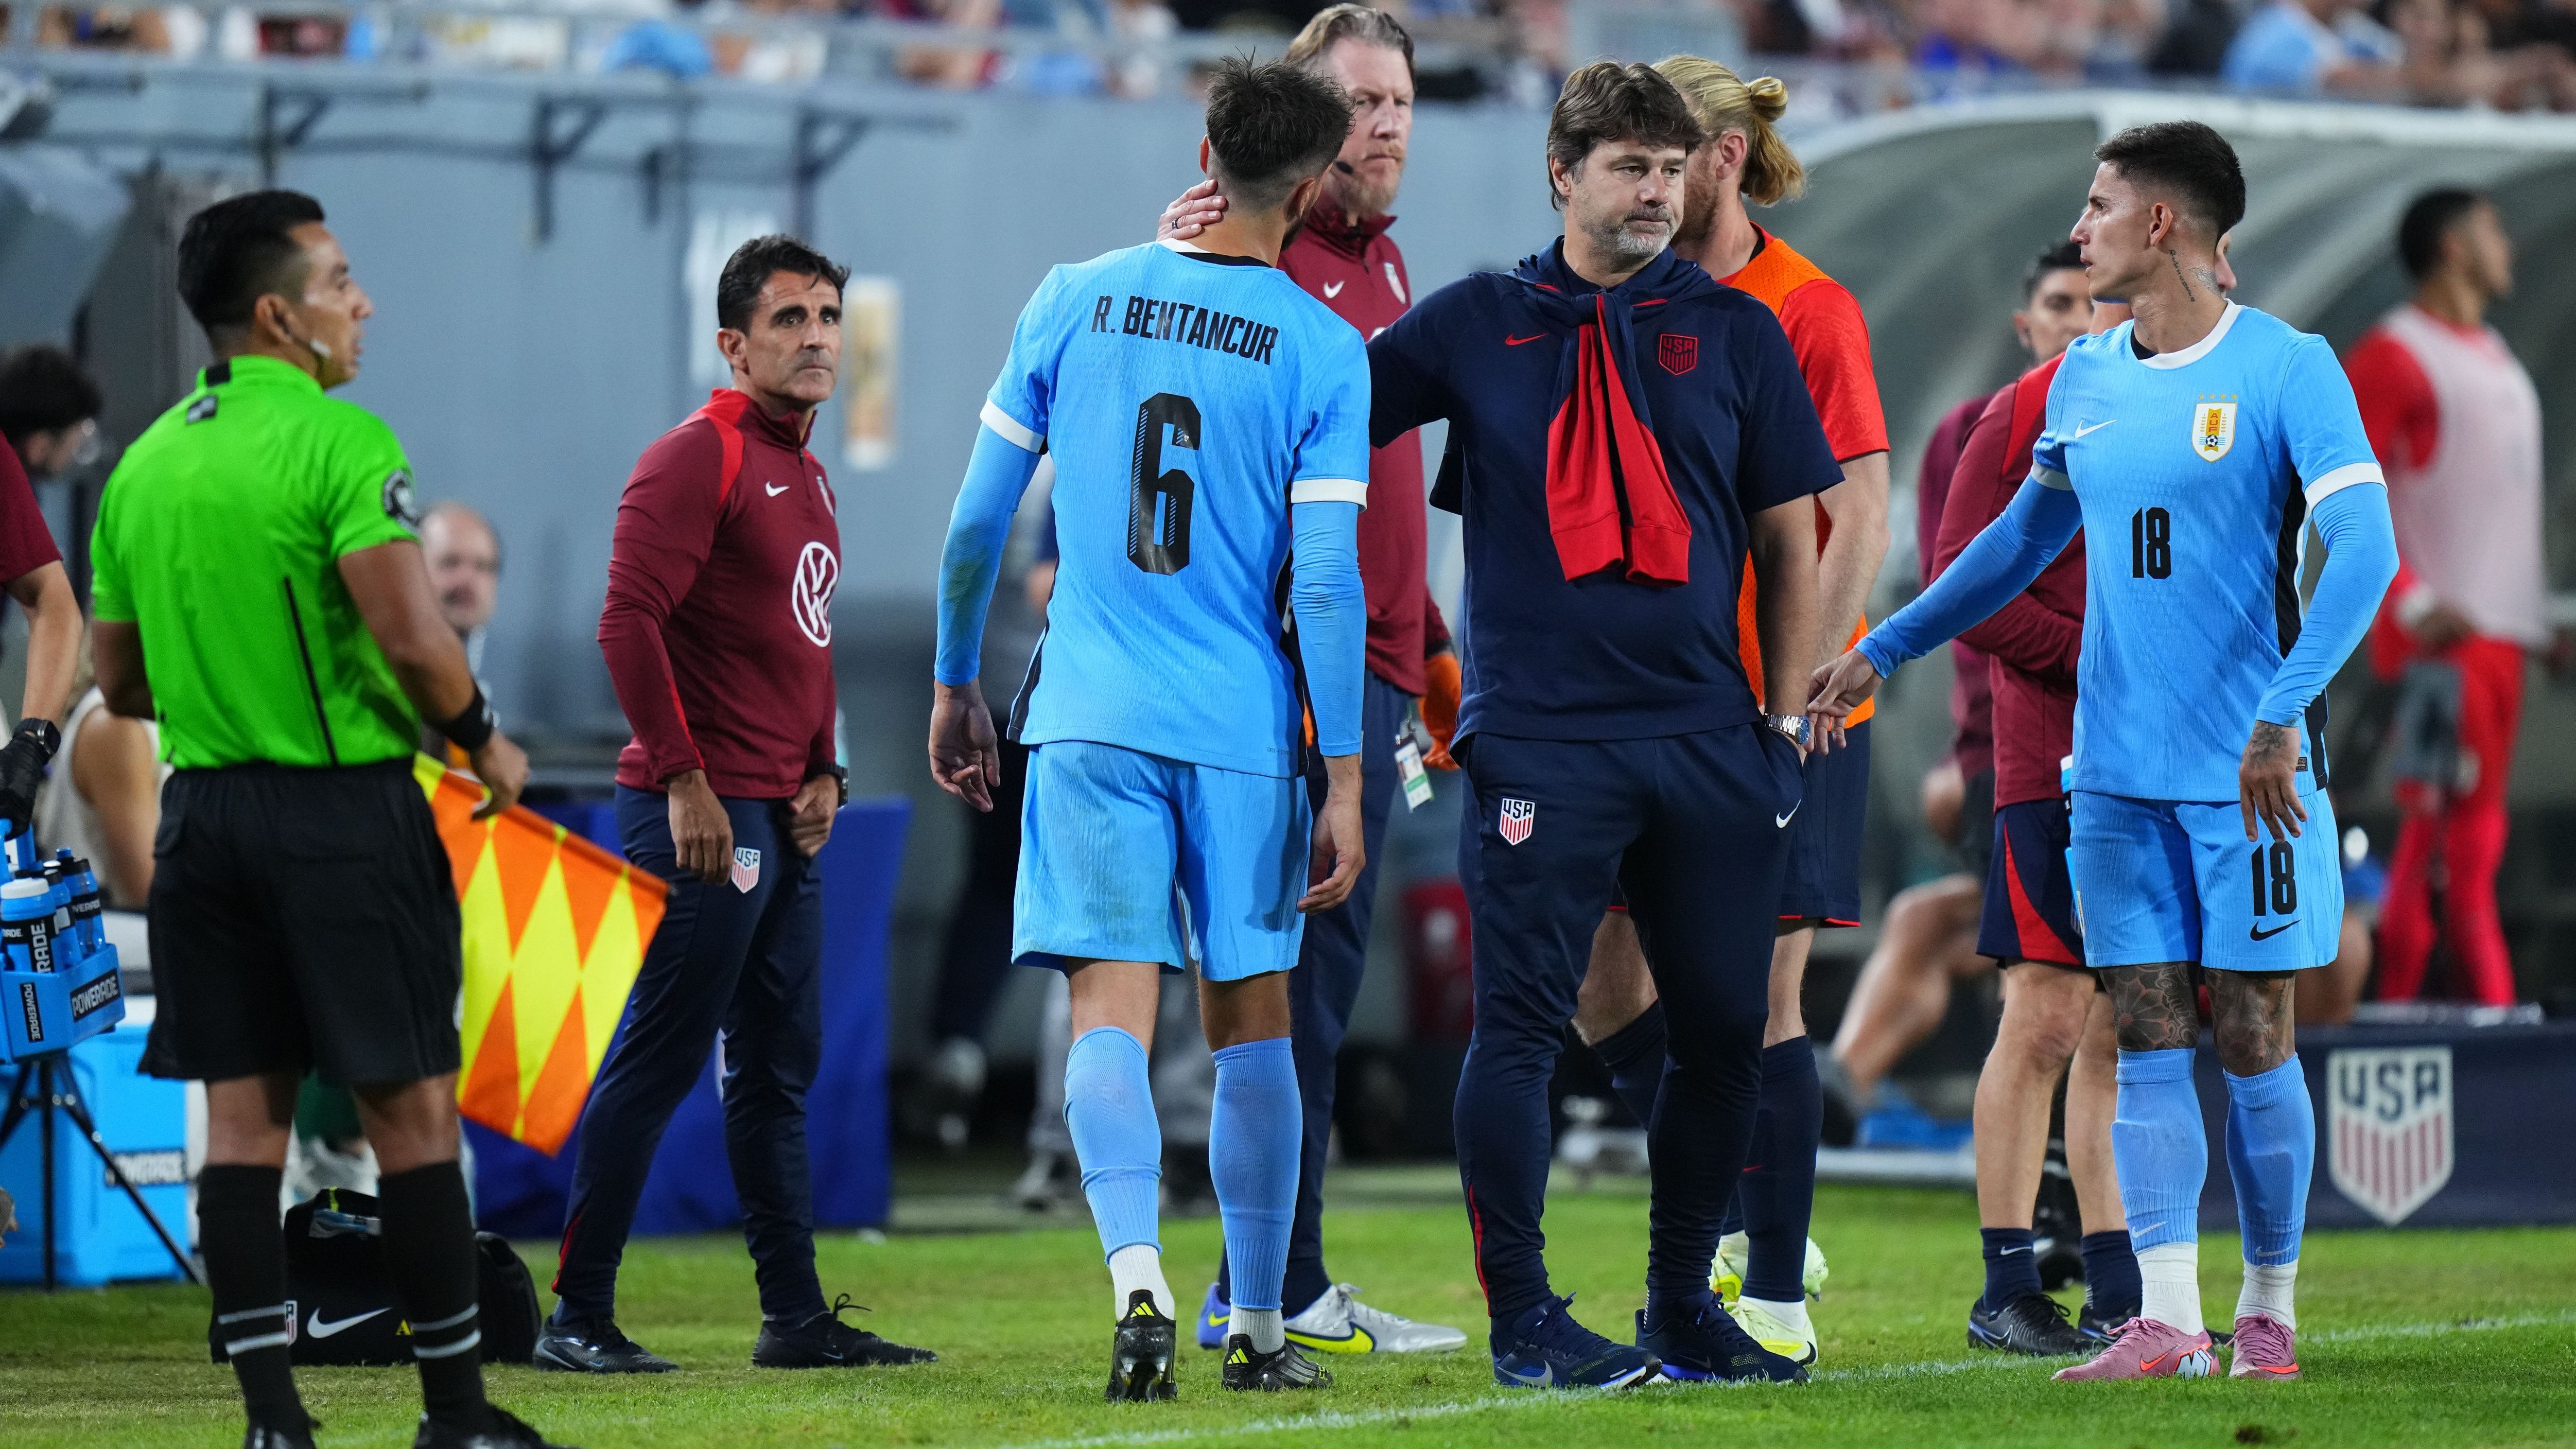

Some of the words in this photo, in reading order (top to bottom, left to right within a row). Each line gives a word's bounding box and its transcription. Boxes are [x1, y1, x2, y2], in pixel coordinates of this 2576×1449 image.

[1091, 295, 1116, 333] R.
[1122, 295, 1279, 366] BENTANCUR
[1663, 337, 1693, 354] USA
[2208, 412, 2219, 433] AUF
[1127, 392, 1202, 576] 6
[2132, 507, 2171, 580] 18
[1503, 799, 1534, 819] USA
[736, 849, 759, 867] USA
[2251, 841, 2297, 916] 18
[23, 984, 41, 1040] POWERADE
[72, 976, 118, 1018] POWERADE
[2340, 1060, 2440, 1123] USA
